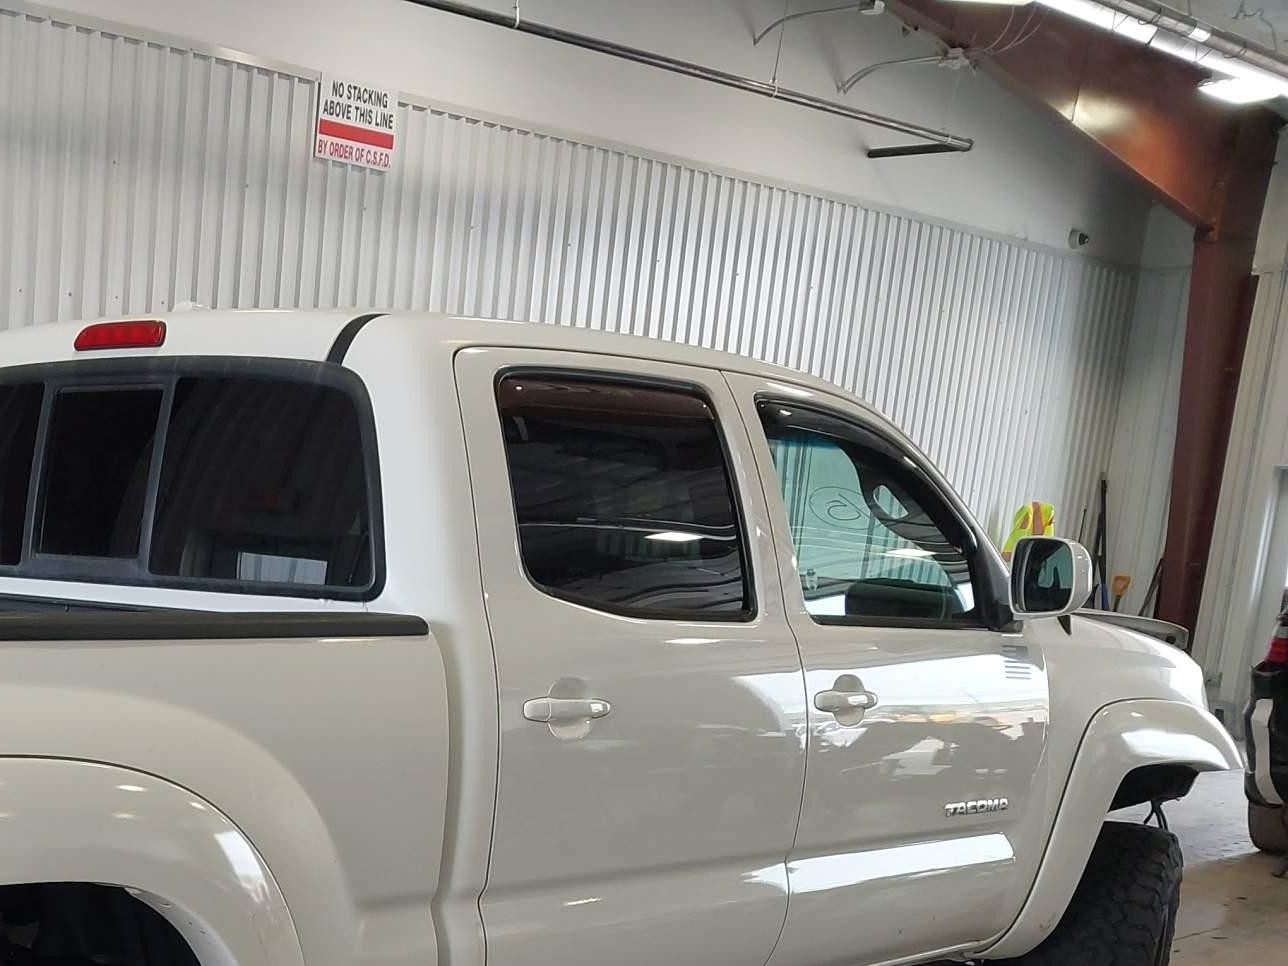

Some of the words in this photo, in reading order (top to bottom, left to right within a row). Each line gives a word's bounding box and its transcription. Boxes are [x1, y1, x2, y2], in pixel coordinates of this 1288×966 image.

[332, 81, 344, 98] NO
[347, 84, 388, 109] STACKING
[323, 99, 352, 120] ABOVE
[354, 106, 372, 125] THIS
[375, 111, 394, 130] LINE
[318, 140, 328, 154] BY
[329, 142, 353, 160] ORDER
[355, 148, 365, 162] OF
[366, 150, 391, 168] C.S.F.D.
